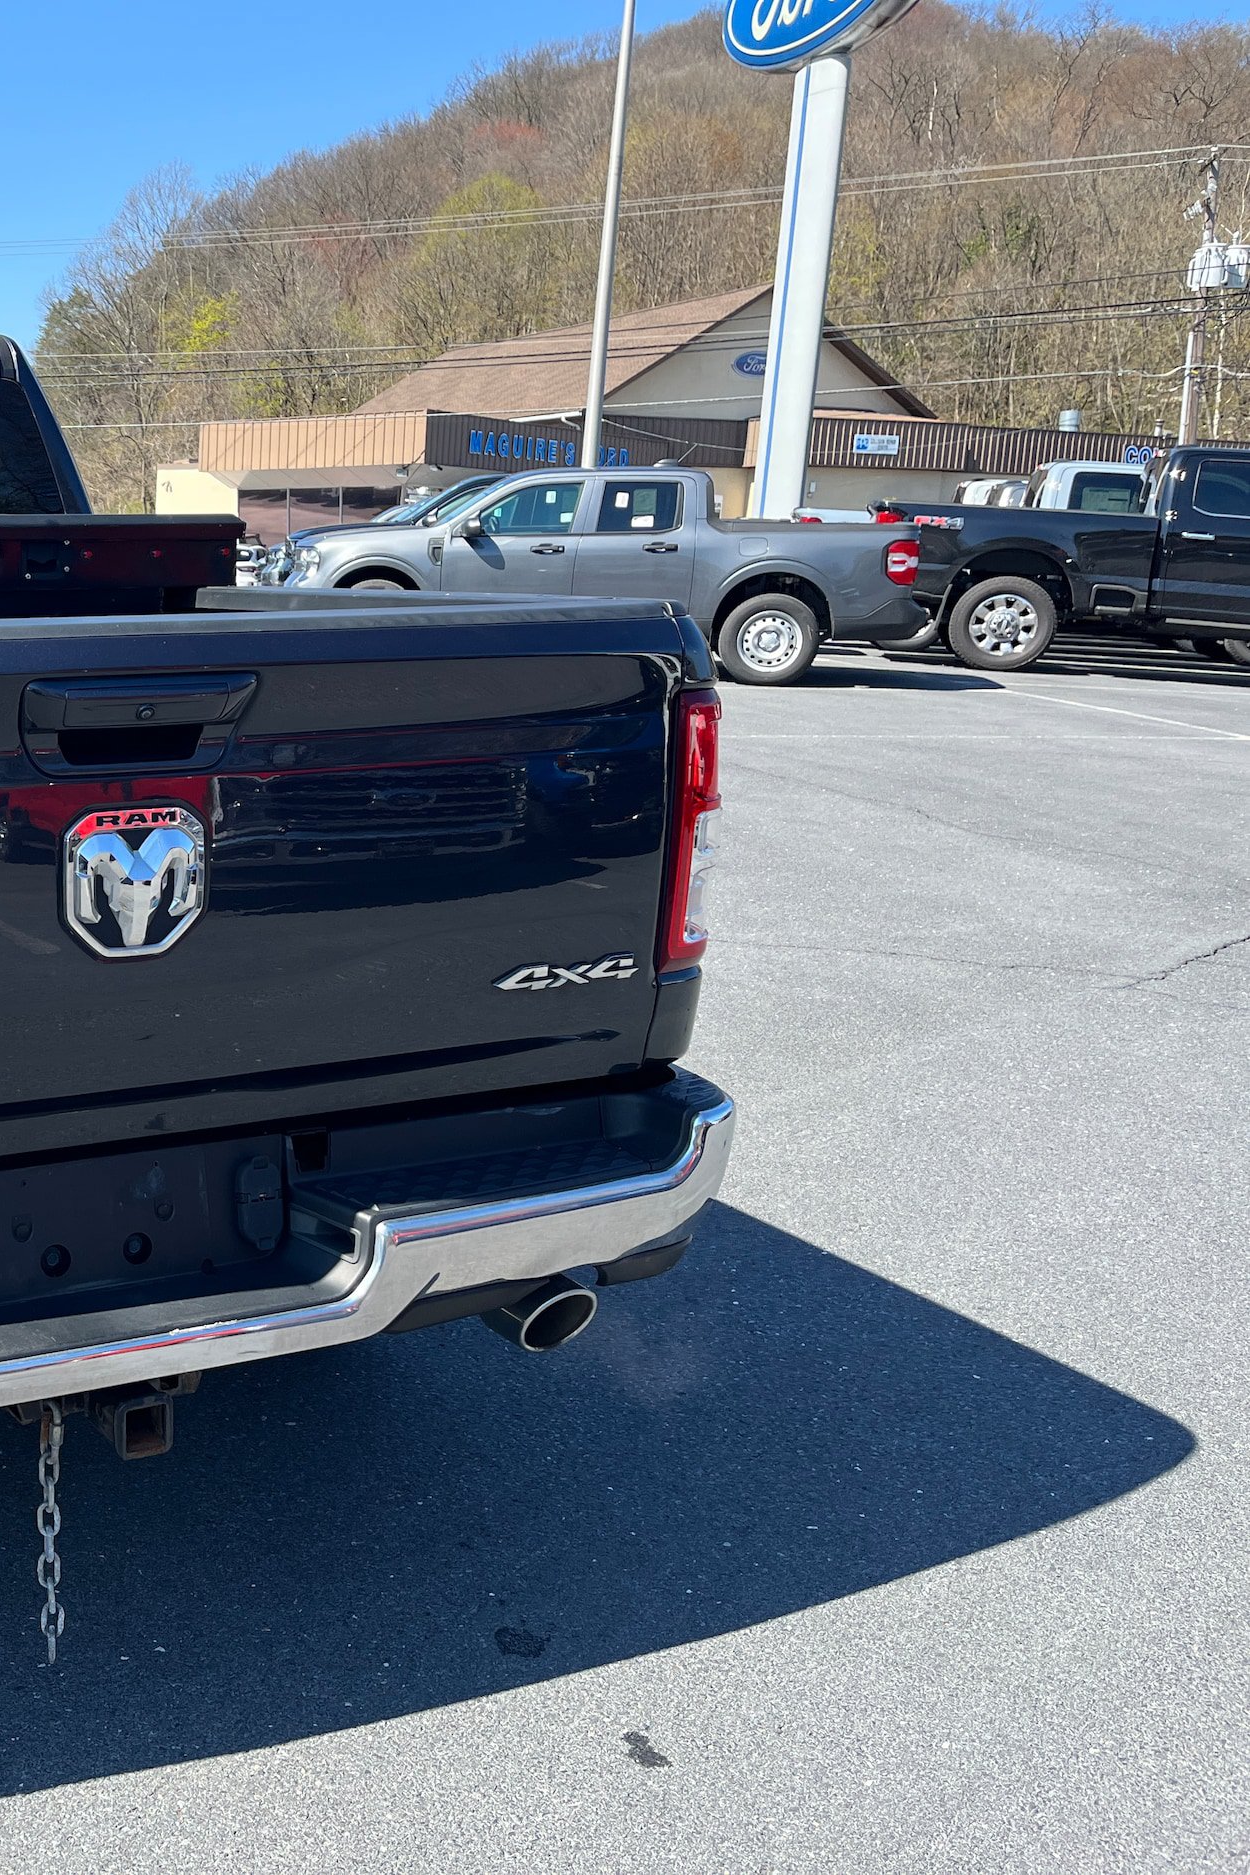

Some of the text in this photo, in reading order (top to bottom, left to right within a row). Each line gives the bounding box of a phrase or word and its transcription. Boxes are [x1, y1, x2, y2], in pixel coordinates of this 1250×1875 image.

[743, 355, 767, 372] For
[469, 429, 629, 466] MAGUIRE'S ORD
[96, 811, 176, 827] RAM
